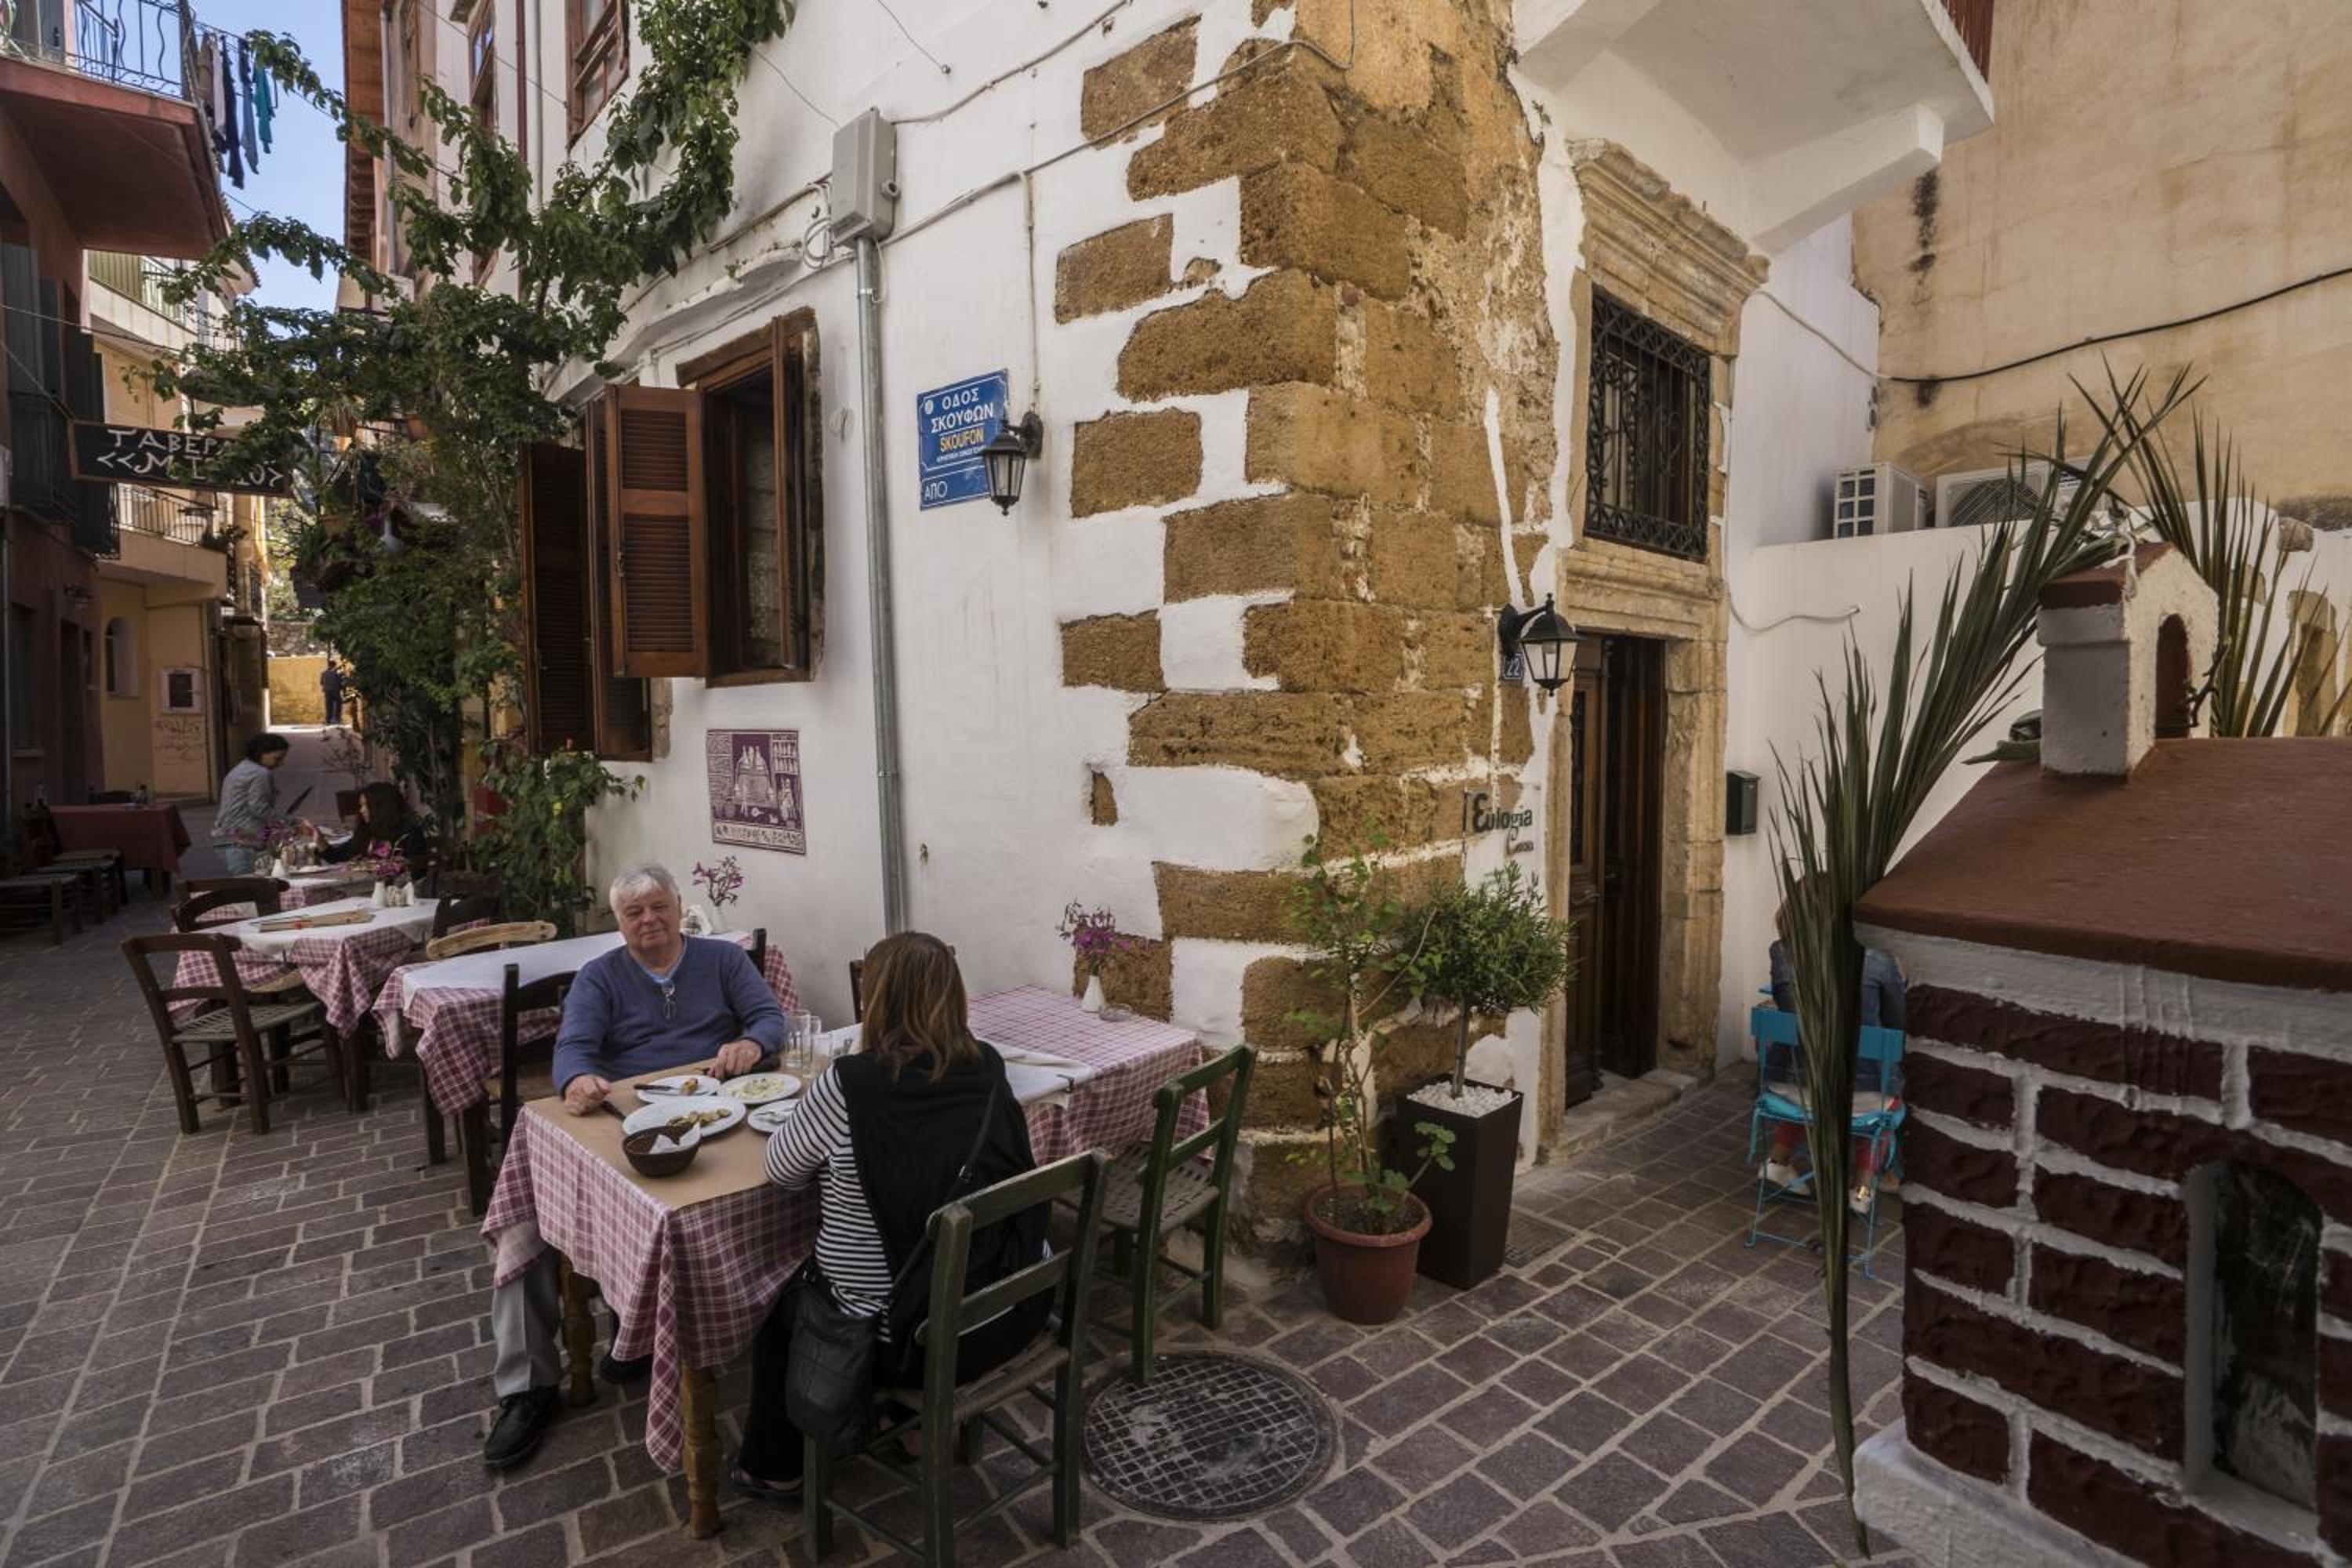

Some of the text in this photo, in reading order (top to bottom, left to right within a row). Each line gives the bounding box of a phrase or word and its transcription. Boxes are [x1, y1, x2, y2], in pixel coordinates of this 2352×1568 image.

[942, 387, 979, 410] ΟΔΟΣ
[931, 403, 994, 434] ΣΚΟΥΦΩΝ
[107, 428, 223, 455] ΤΑΒΕΡ
[940, 426, 985, 452] SKOUFON
[924, 481, 948, 501] ΑΠΟ
[1472, 793, 1533, 840] Eulogia
